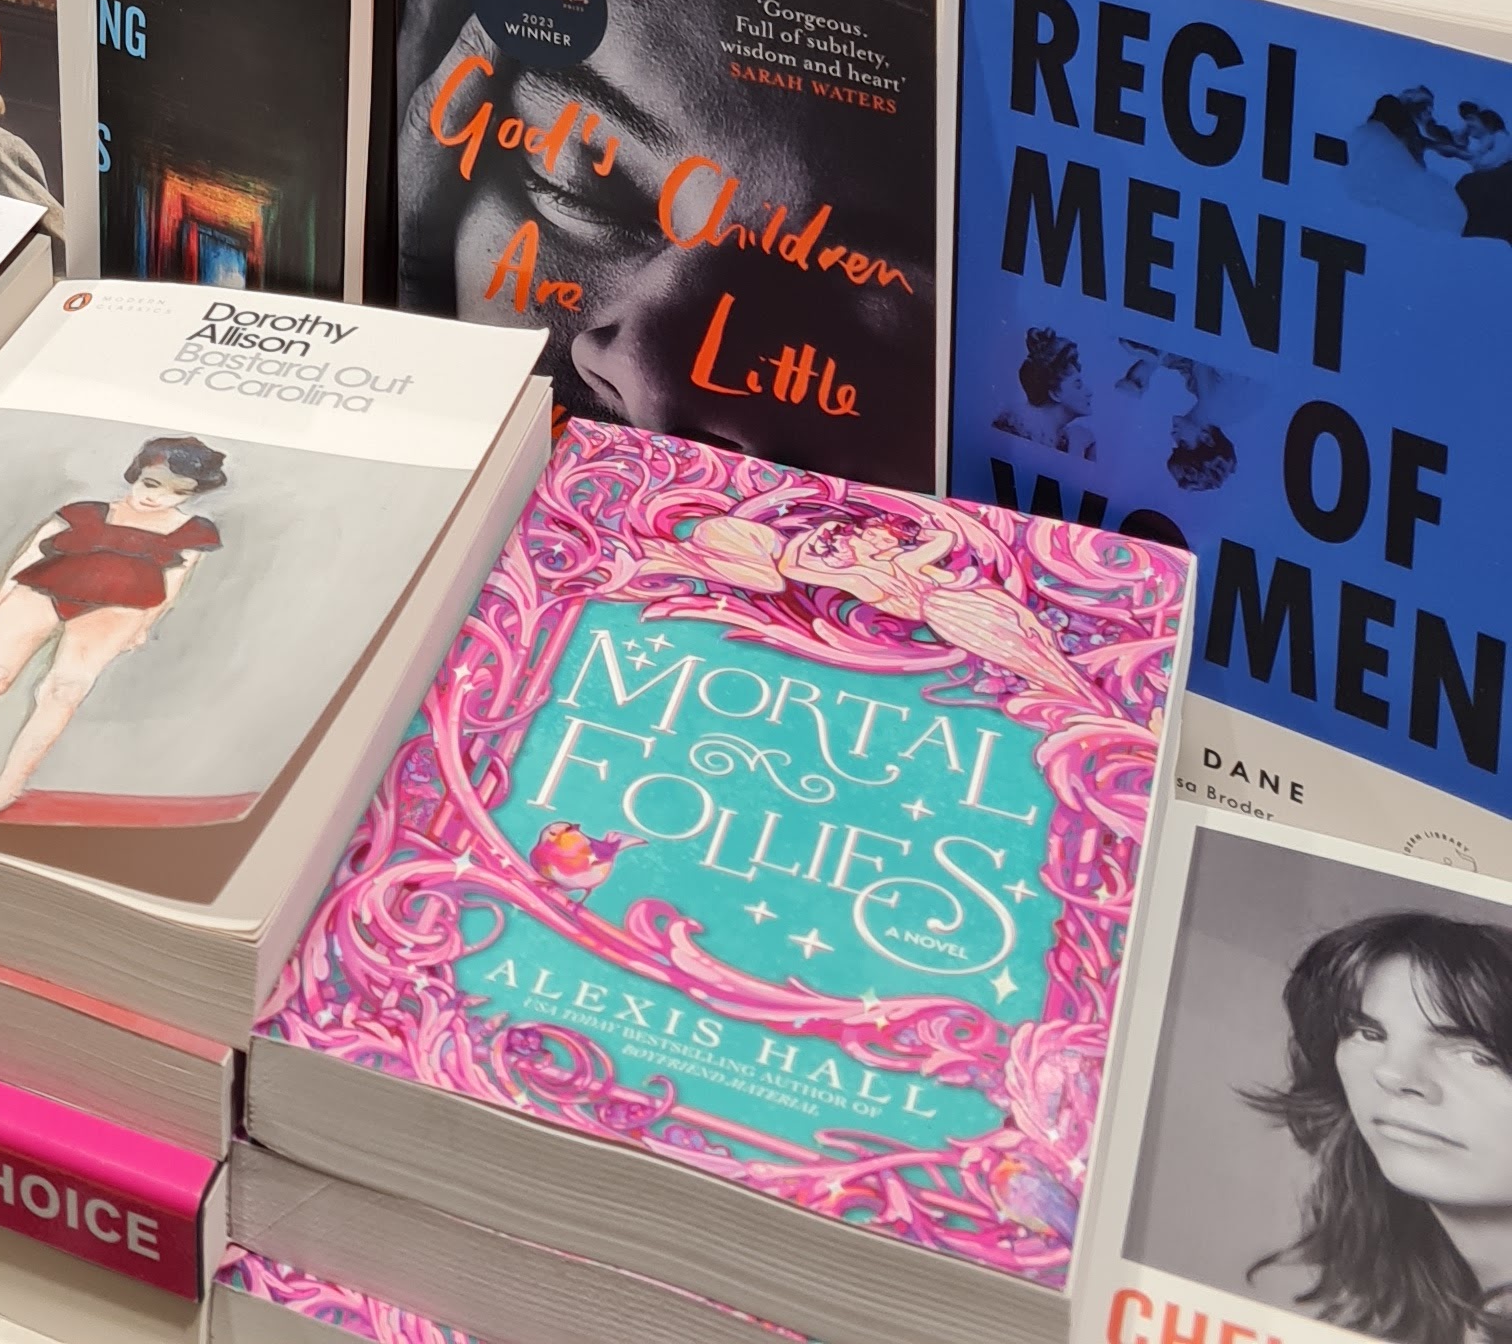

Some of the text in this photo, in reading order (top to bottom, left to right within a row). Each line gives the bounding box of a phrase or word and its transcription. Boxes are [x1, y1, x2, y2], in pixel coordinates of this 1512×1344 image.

[504, 20, 572, 48] WINNER
[522, 12, 555, 29] 2023
[736, 15, 891, 70] Full of subtlety,
[720, 38, 798, 69] wisdom
[803, 54, 842, 78] and
[729, 62, 898, 114] SARAH WATERS
[430, 53, 618, 184] God's
[659, 154, 916, 296] Children
[486, 219, 585, 314] Are
[1000, 144, 1366, 373] MENT
[185, 323, 311, 358] Allison
[201, 301, 359, 346] Dorothy
[174, 342, 415, 399] Bastard Out
[690, 292, 863, 418] Little
[158, 363, 373, 414] of Carolina
[1284, 399, 1448, 570] OF
[558, 626, 1039, 829] MORTAL
[1202, 746, 1306, 805] DANE
[1206, 783, 1276, 822] Broder
[526, 712, 1020, 973] FOLLIES
[484, 958, 724, 1049] ALEXIS
[754, 1037, 939, 1119] HALL
